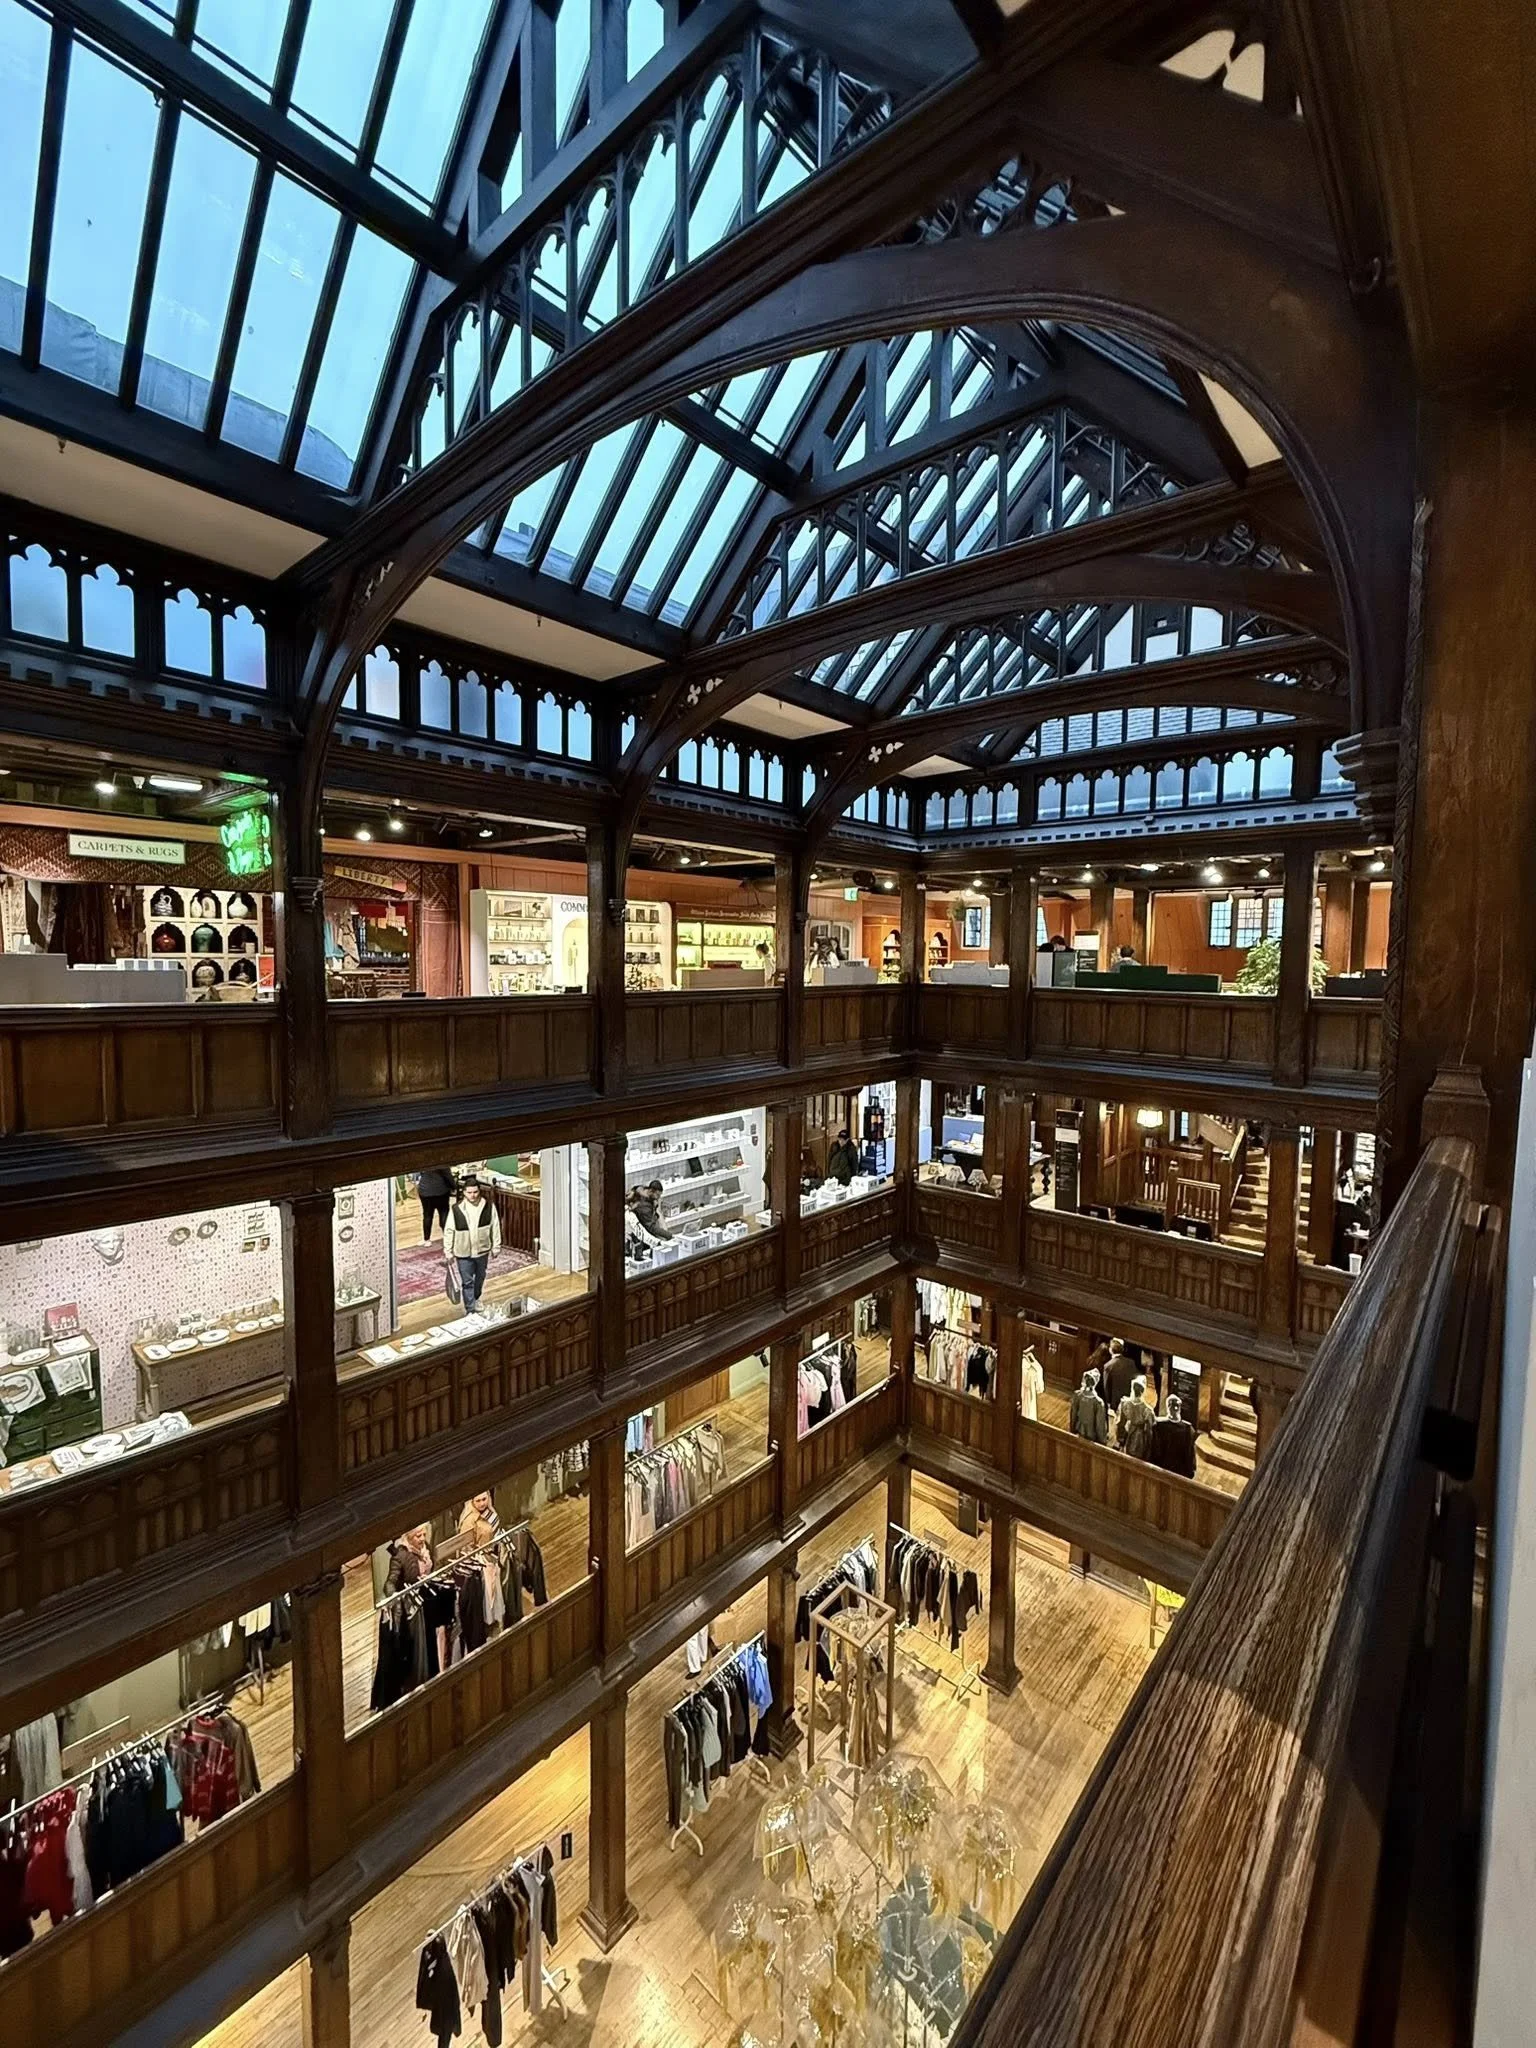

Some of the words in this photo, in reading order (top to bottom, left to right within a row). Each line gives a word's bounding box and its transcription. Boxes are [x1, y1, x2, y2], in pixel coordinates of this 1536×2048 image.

[78, 840, 133, 855] CARPETS
[135, 846, 145, 855] &
[148, 846, 179, 857] RUGS
[342, 868, 387, 885] LIBERTY
[560, 901, 588, 913] COMM
